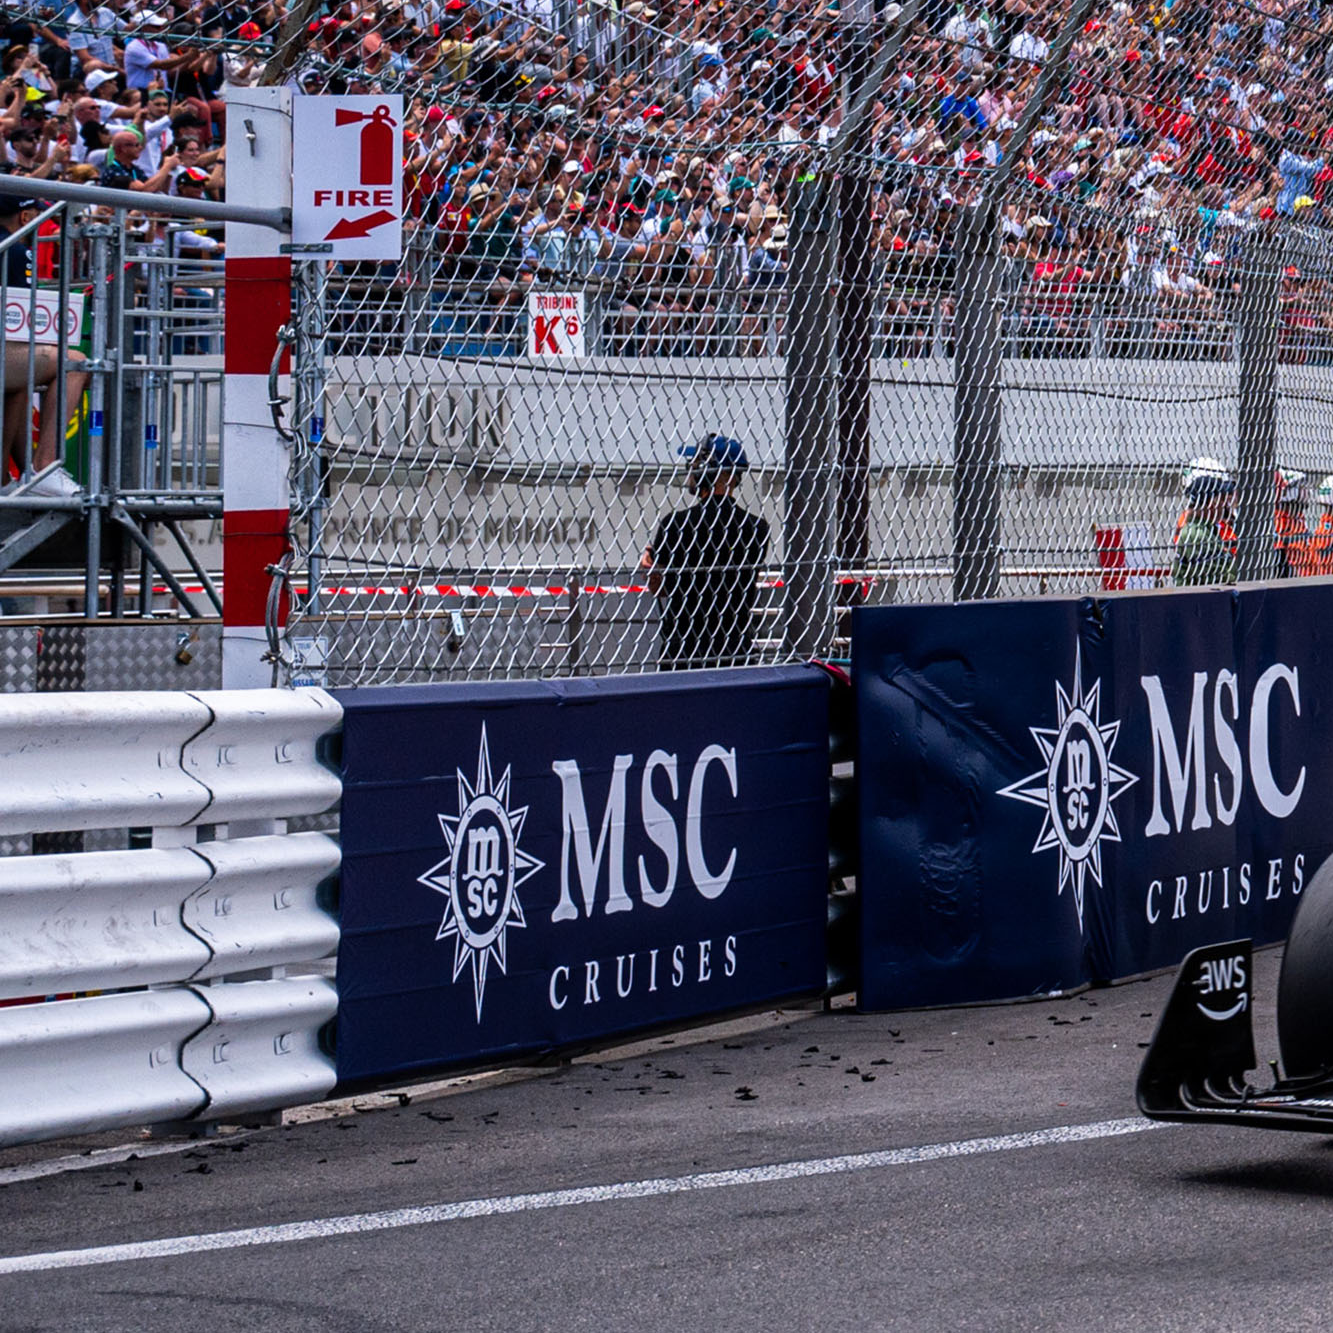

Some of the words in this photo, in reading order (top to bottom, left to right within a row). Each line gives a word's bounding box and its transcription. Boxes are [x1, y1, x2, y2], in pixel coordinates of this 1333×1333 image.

[314, 190, 393, 207] FIRE
[536, 296, 577, 310] TRIBUNE
[1141, 663, 1306, 837] MSC
[551, 744, 738, 922] MSC
[1146, 854, 1306, 924] CRUISES
[550, 936, 737, 1010] CRUISES
[1198, 955, 1246, 995] aws
